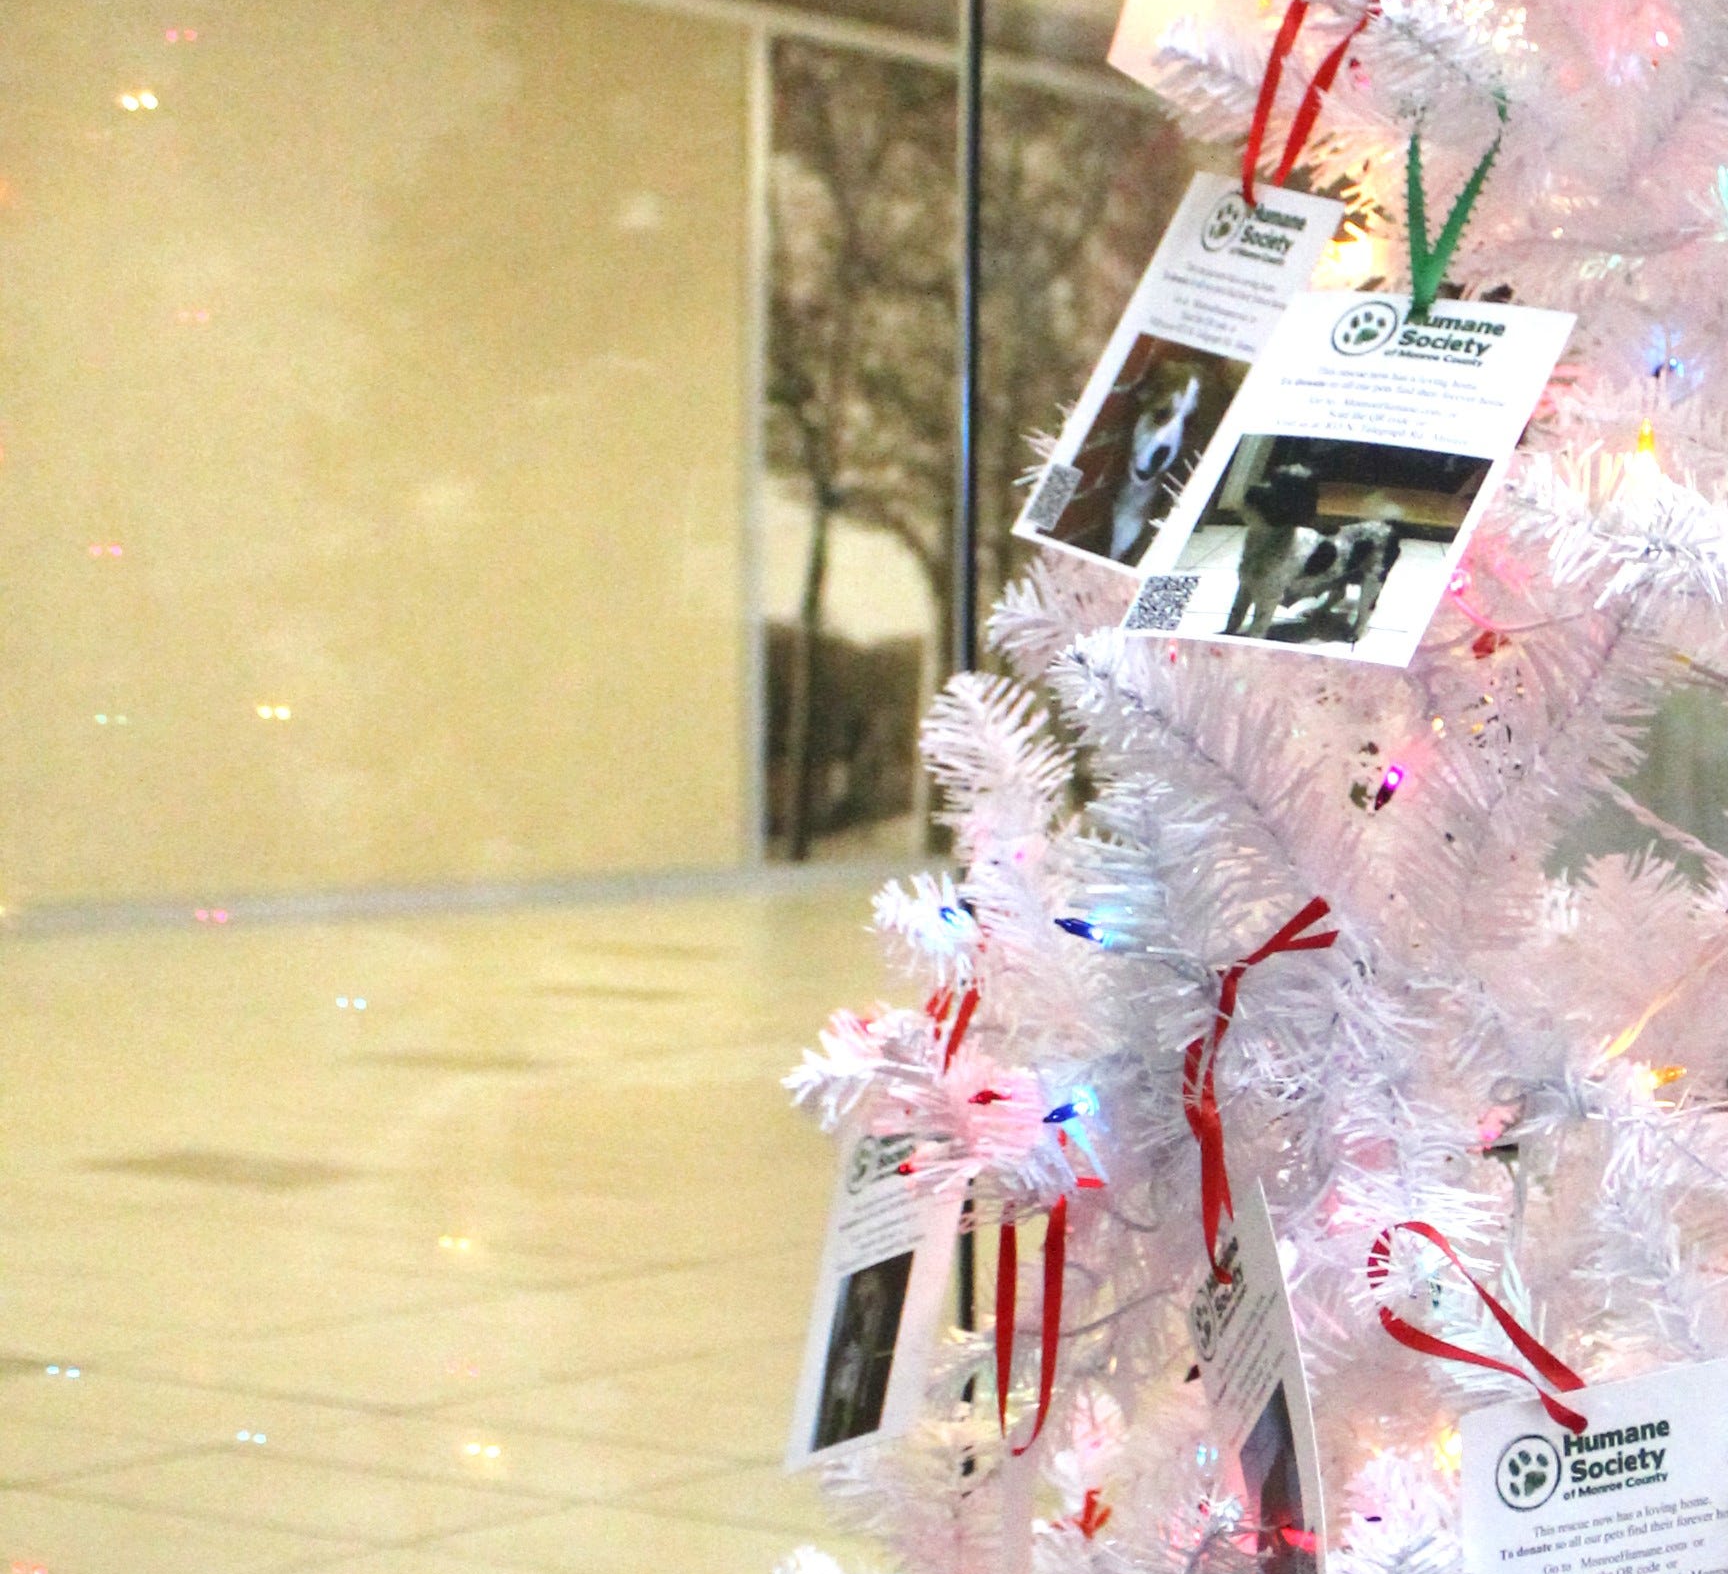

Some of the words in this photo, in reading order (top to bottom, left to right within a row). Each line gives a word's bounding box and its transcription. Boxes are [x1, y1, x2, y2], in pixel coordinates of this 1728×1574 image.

[1562, 1418, 1670, 1457] Humane
[1569, 1446, 1666, 1483] Society
[1562, 1488, 1575, 1501] of
[1577, 1481, 1622, 1497] Monroe
[1624, 1471, 1668, 1488] County
